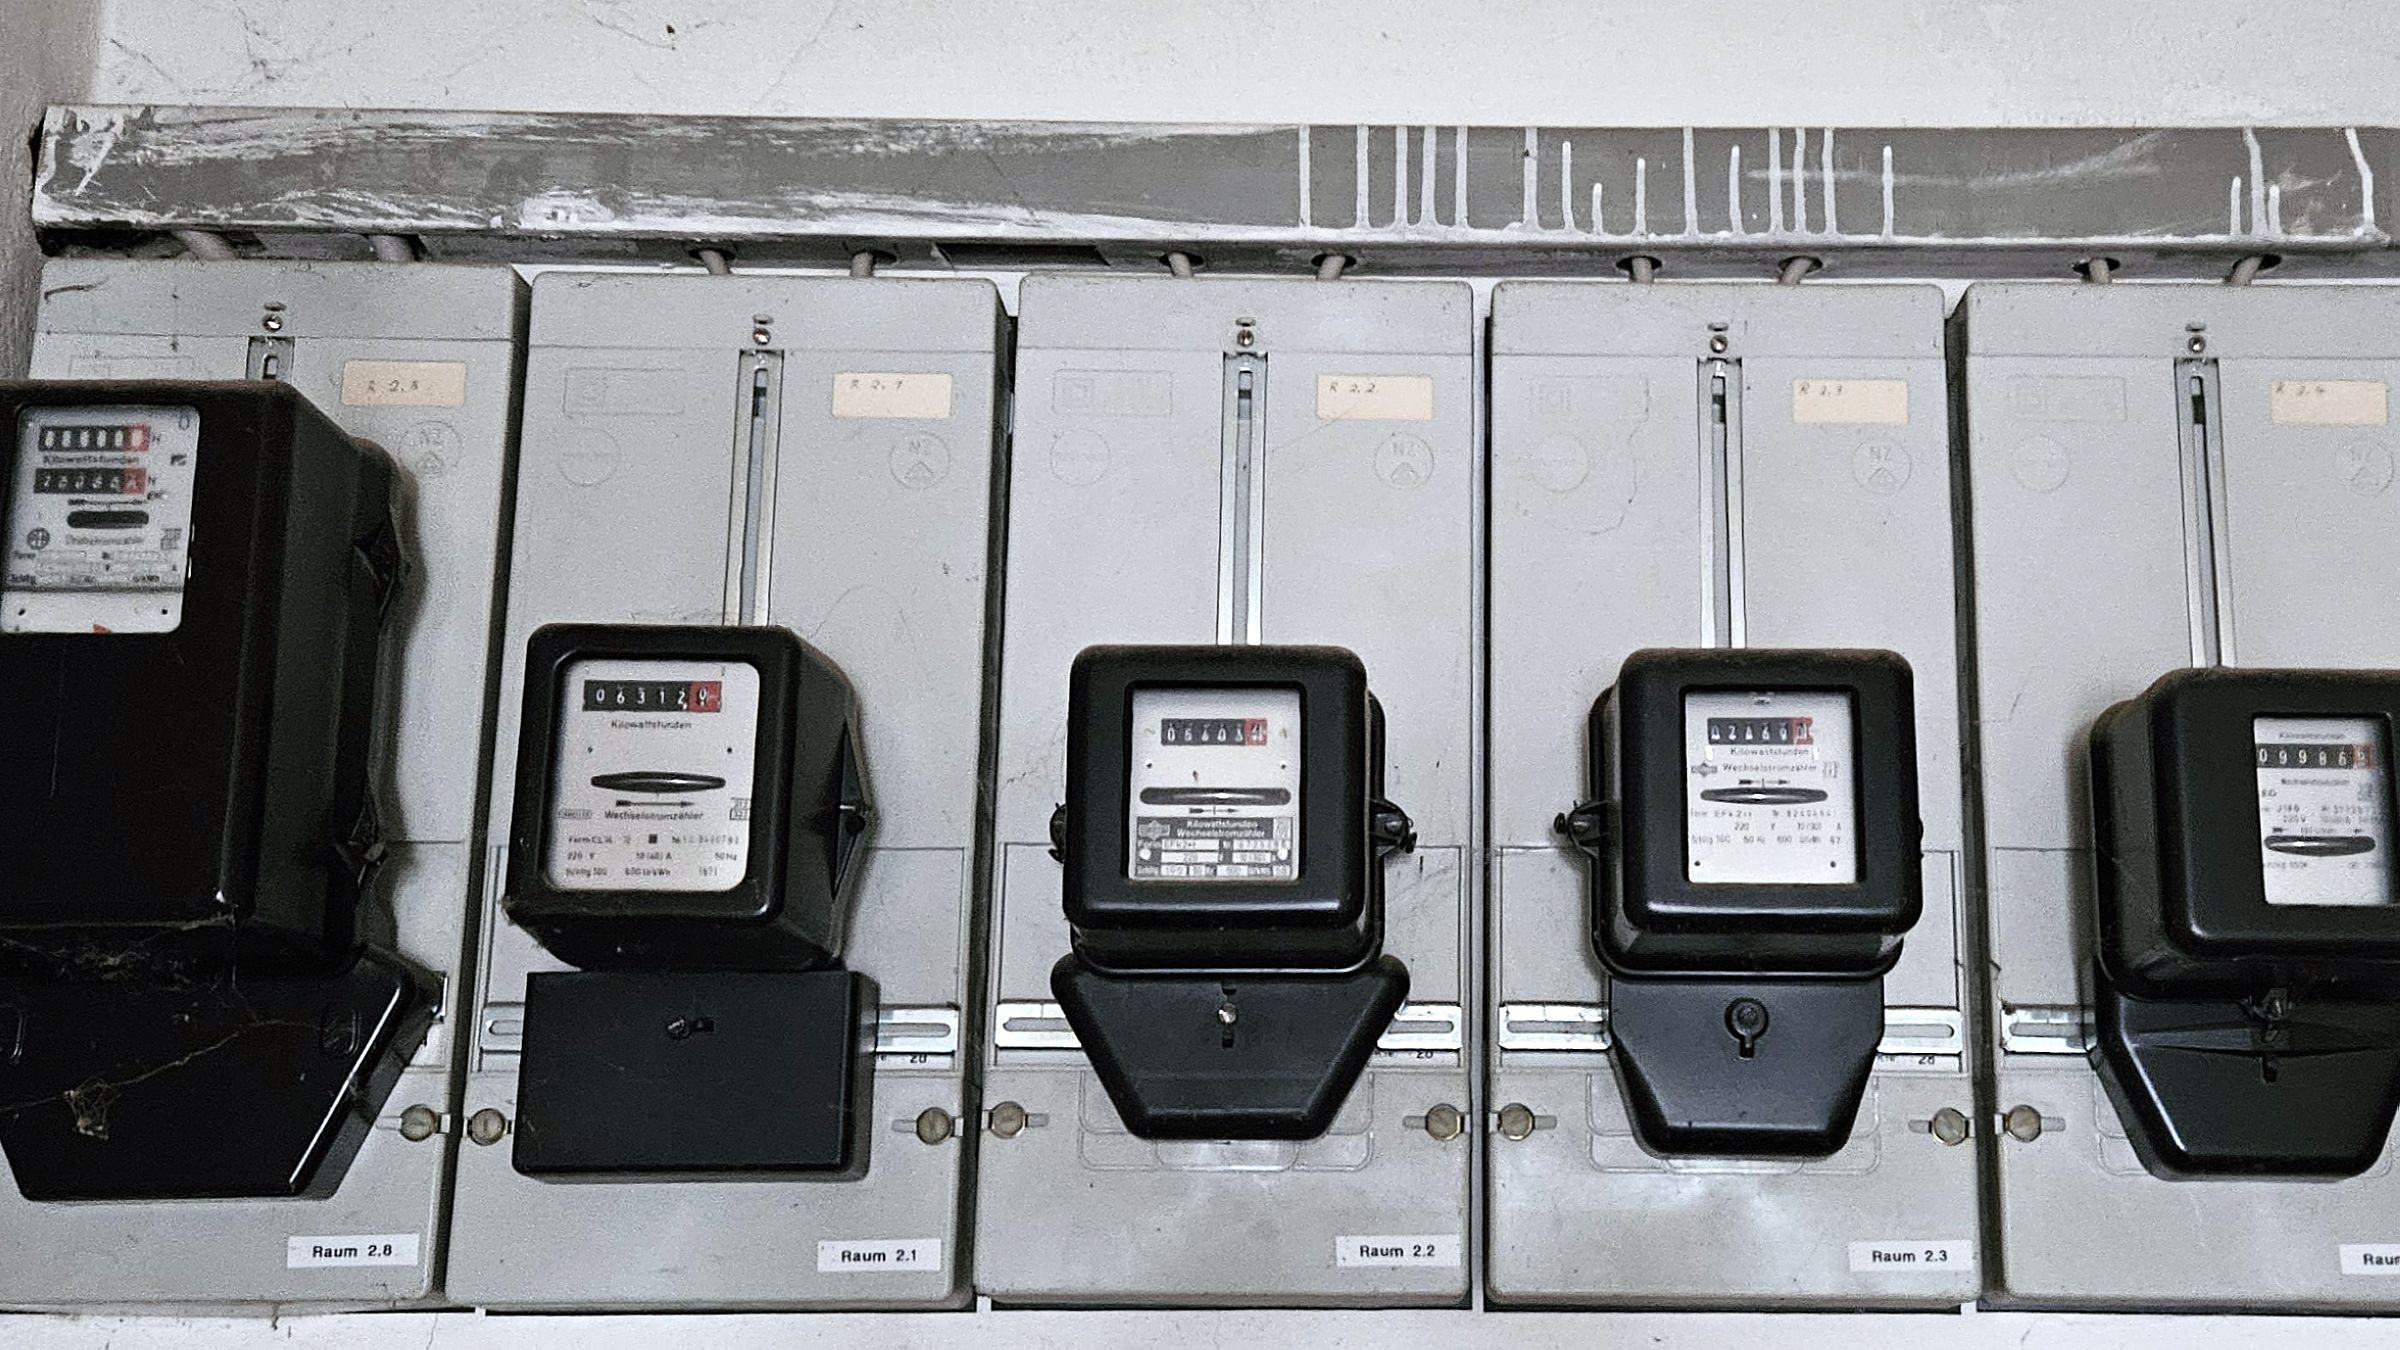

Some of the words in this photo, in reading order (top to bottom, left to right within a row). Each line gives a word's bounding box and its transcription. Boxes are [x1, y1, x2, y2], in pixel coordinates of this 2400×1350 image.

[1349, 383, 1376, 393] 2.2
[312, 1245, 359, 1258] Raum
[367, 1244, 393, 1257] 2.8
[841, 1250, 887, 1262] Raum
[896, 1249, 917, 1262] 2.1
[1359, 1245, 1404, 1257] Raum
[1412, 1244, 1436, 1257] 2.2
[1872, 1250, 1916, 1263] Raum
[1924, 1249, 1948, 1262] 2.3
